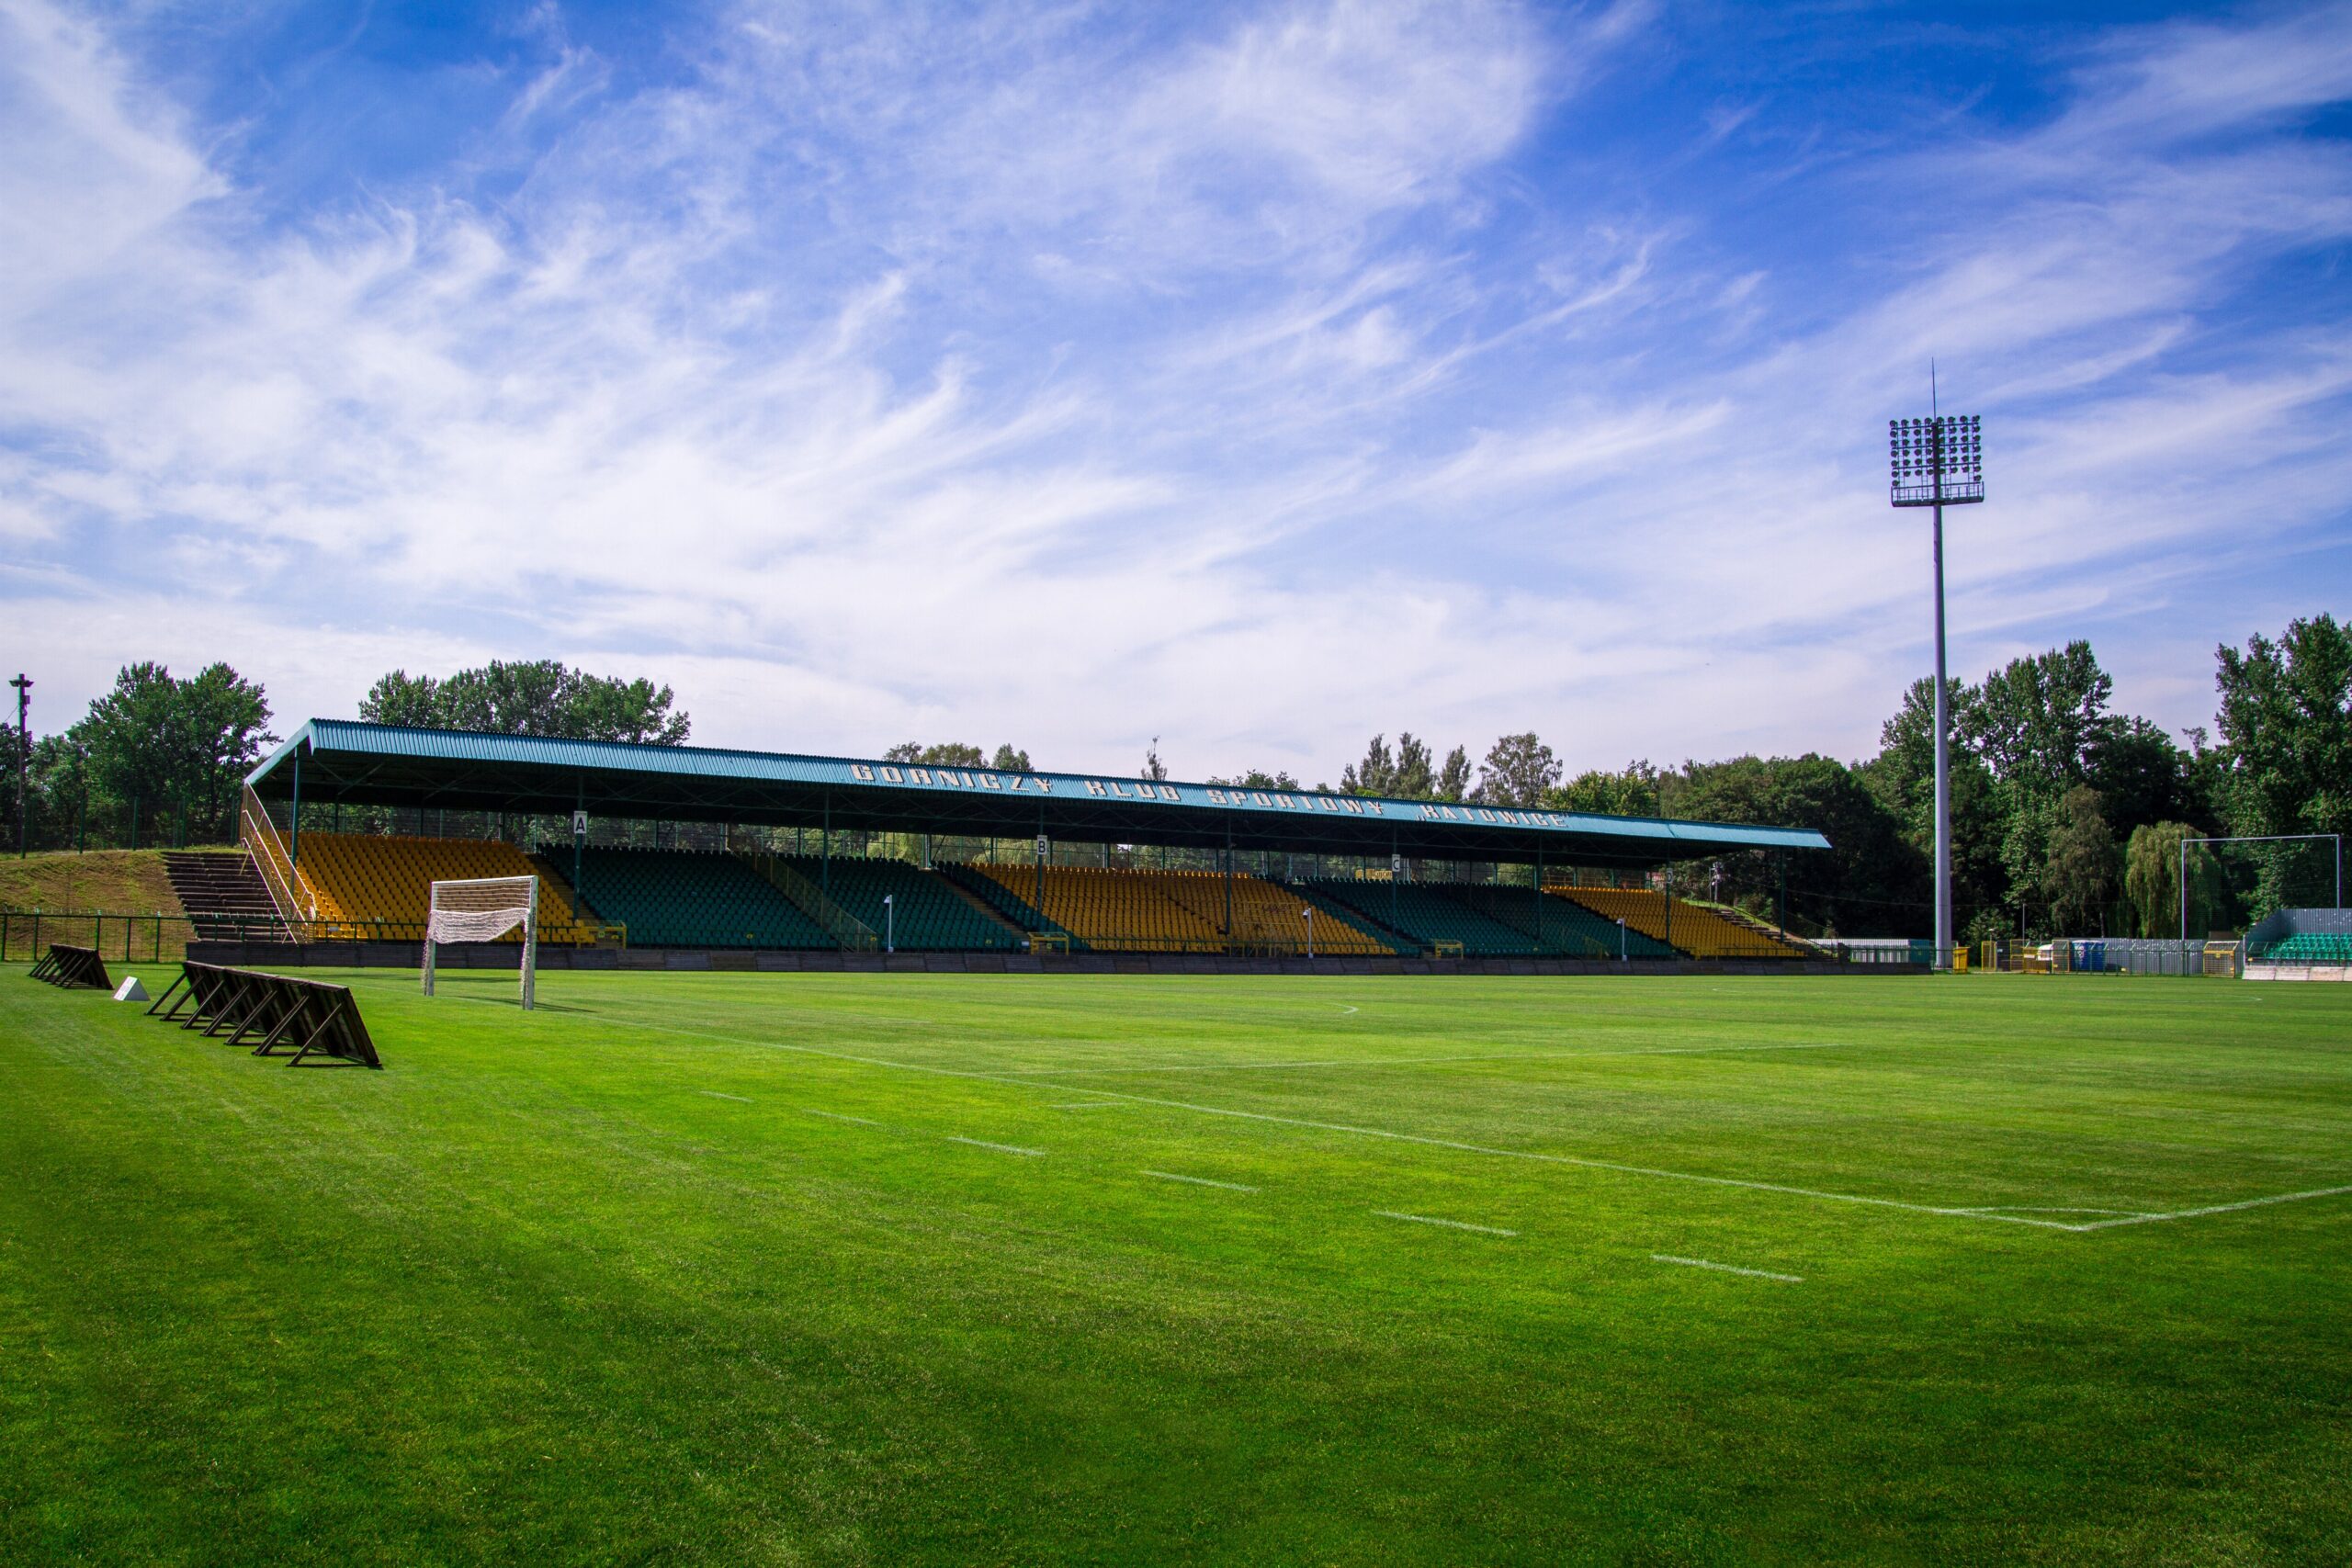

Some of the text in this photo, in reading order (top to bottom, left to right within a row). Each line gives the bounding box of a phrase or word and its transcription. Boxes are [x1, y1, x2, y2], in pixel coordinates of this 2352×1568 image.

[1084, 781, 1181, 801] KLUB
[1206, 790, 1383, 815] SPORTOWY
[575, 816, 585, 831] A
[1038, 840, 1046, 852] B
[1392, 859, 1399, 870] C
